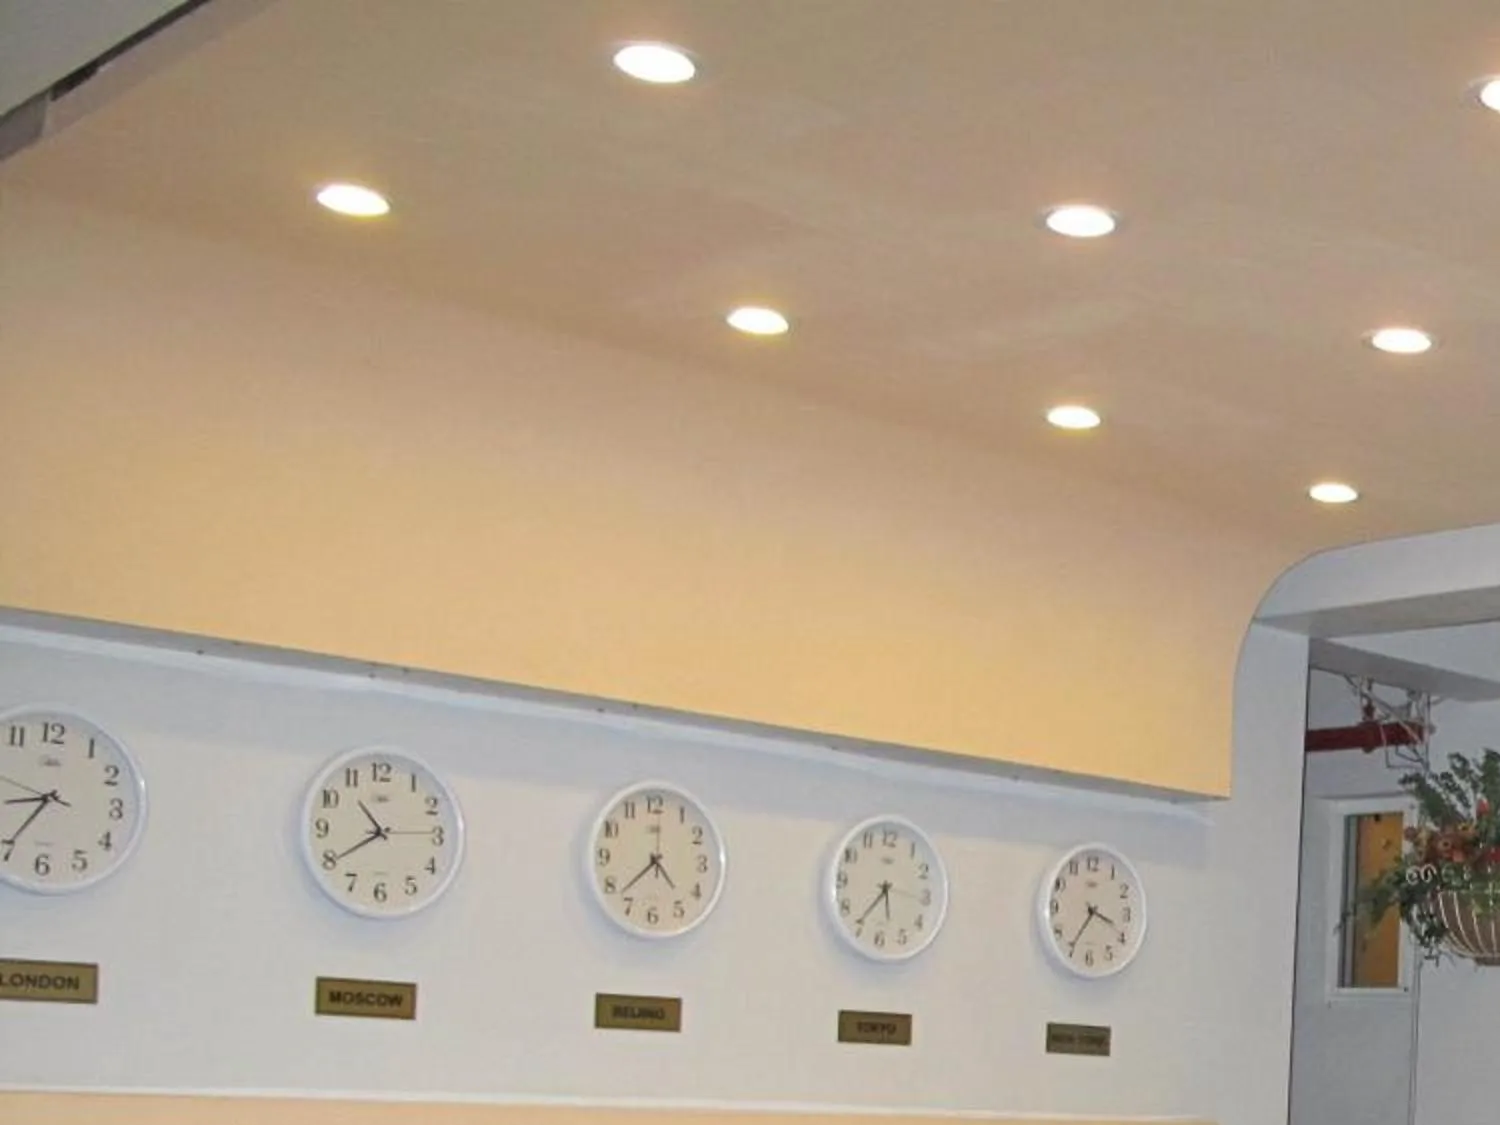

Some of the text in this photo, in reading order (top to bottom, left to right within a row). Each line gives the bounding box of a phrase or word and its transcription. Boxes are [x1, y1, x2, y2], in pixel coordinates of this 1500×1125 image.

[8, 725, 25, 747] 11
[42, 722, 66, 745] 12
[87, 737, 95, 759] 1
[104, 765, 120, 786] 2
[345, 767, 359, 788] 11
[371, 762, 392, 782] 12
[410, 773, 417, 793] 1
[109, 797, 124, 820] 3
[322, 788, 339, 809] 10
[424, 796, 439, 816] 2
[646, 795, 664, 814] 12
[624, 801, 636, 820] 11
[679, 806, 685, 824] 1
[315, 817, 329, 839] 9
[431, 825, 445, 847] 3
[604, 820, 619, 838] 10
[691, 826, 703, 845] 2
[1, 838, 15, 862] 7
[98, 831, 112, 850] 4
[34, 854, 51, 876] 6
[71, 849, 88, 872] 5
[322, 849, 337, 870] 8
[424, 856, 436, 875] 4
[598, 848, 610, 866] 9
[697, 855, 708, 873] 3
[344, 872, 358, 893] 7
[373, 882, 387, 903] 6
[404, 875, 418, 896] 5
[604, 876, 616, 894] 8
[691, 882, 702, 899] 4
[623, 897, 634, 917] 7
[647, 906, 659, 925] 6
[673, 900, 685, 918] 5
[0, 971, 80, 992] LONDON
[328, 990, 404, 1008] MOSCOW
